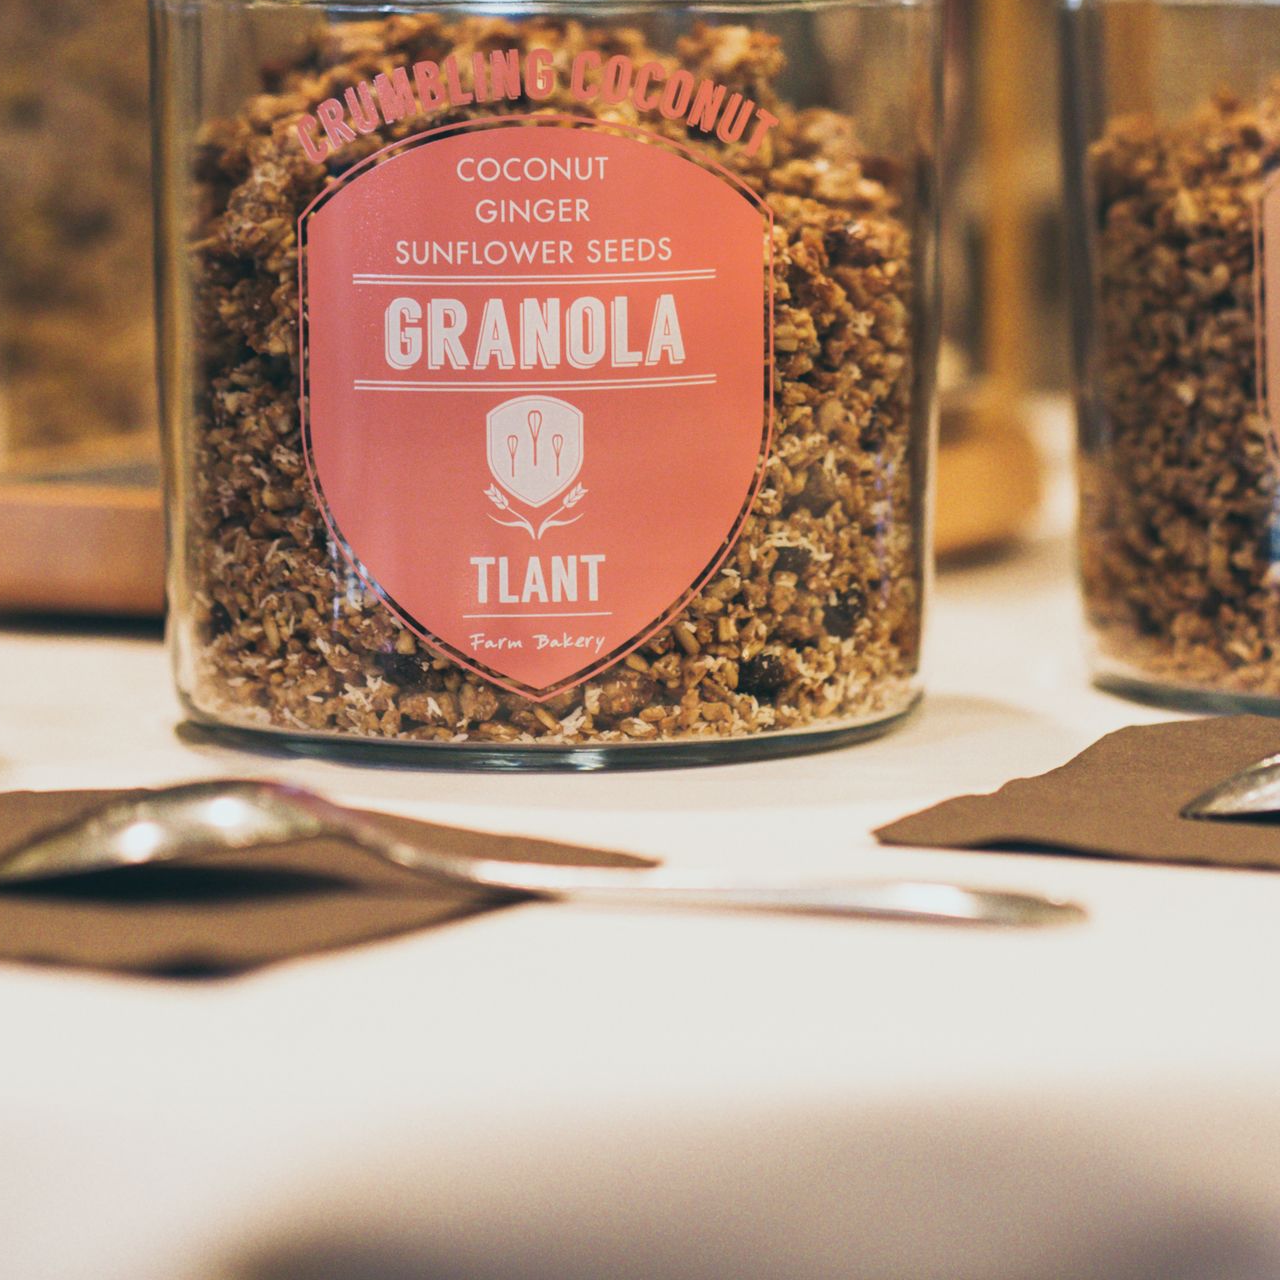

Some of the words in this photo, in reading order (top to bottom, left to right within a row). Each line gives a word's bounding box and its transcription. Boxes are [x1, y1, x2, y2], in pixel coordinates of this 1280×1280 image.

[297, 48, 555, 164] CRUMBLING
[571, 50, 780, 158] COCONUT
[456, 156, 609, 182] COCONUT
[475, 198, 590, 224] GINGER
[395, 240, 574, 266] SUNFLOWER
[586, 237, 673, 262] SEEDS
[384, 293, 687, 371] GRANOLA
[469, 554, 606, 604] TLANT
[470, 633, 523, 652] Farm
[532, 632, 606, 654] Bakery
